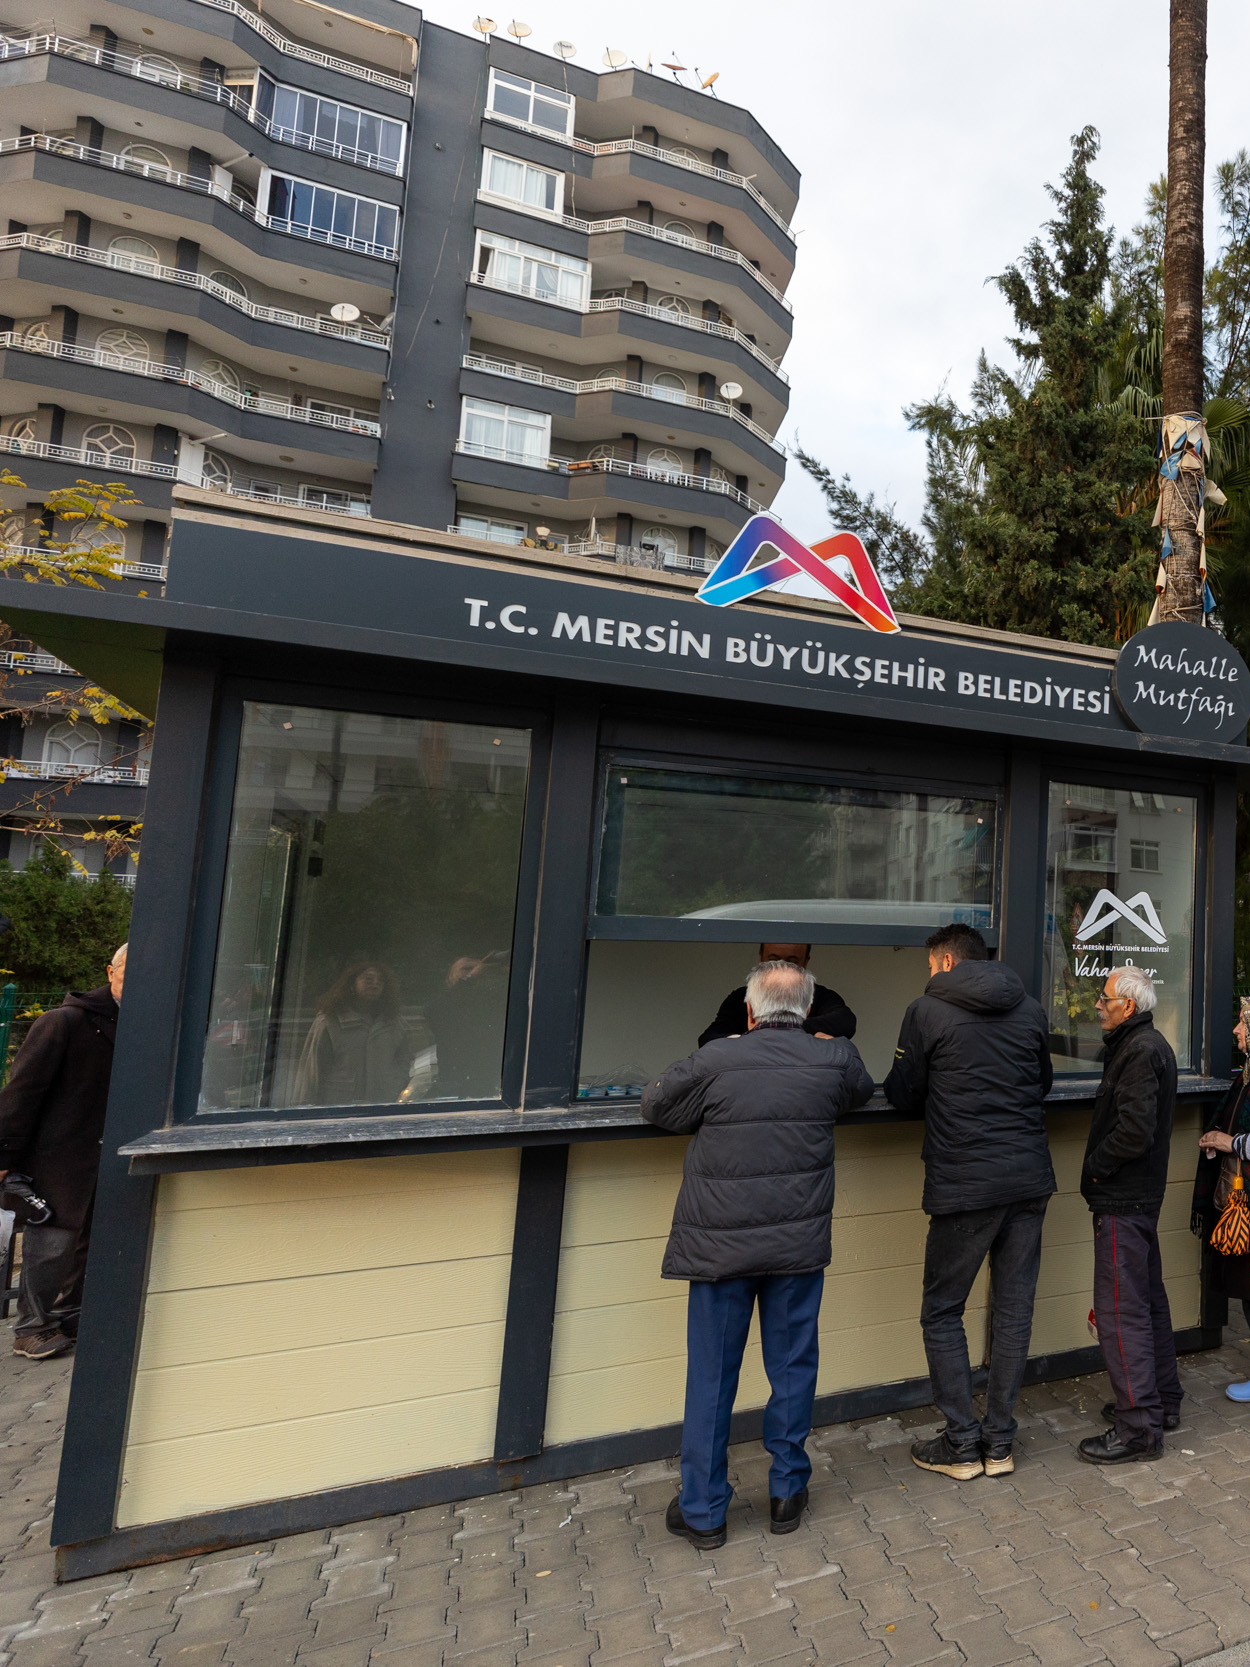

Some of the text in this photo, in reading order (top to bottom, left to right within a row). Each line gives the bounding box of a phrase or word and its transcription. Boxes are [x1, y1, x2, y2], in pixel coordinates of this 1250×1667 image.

[464, 597, 1111, 715] T.C. MERSİN BÜYÜKŞEHİR BELEDİYESİ
[1133, 645, 1239, 682] Mahalle
[1132, 680, 1236, 730] Mutfağı
[1075, 955, 1115, 977] Vaha
